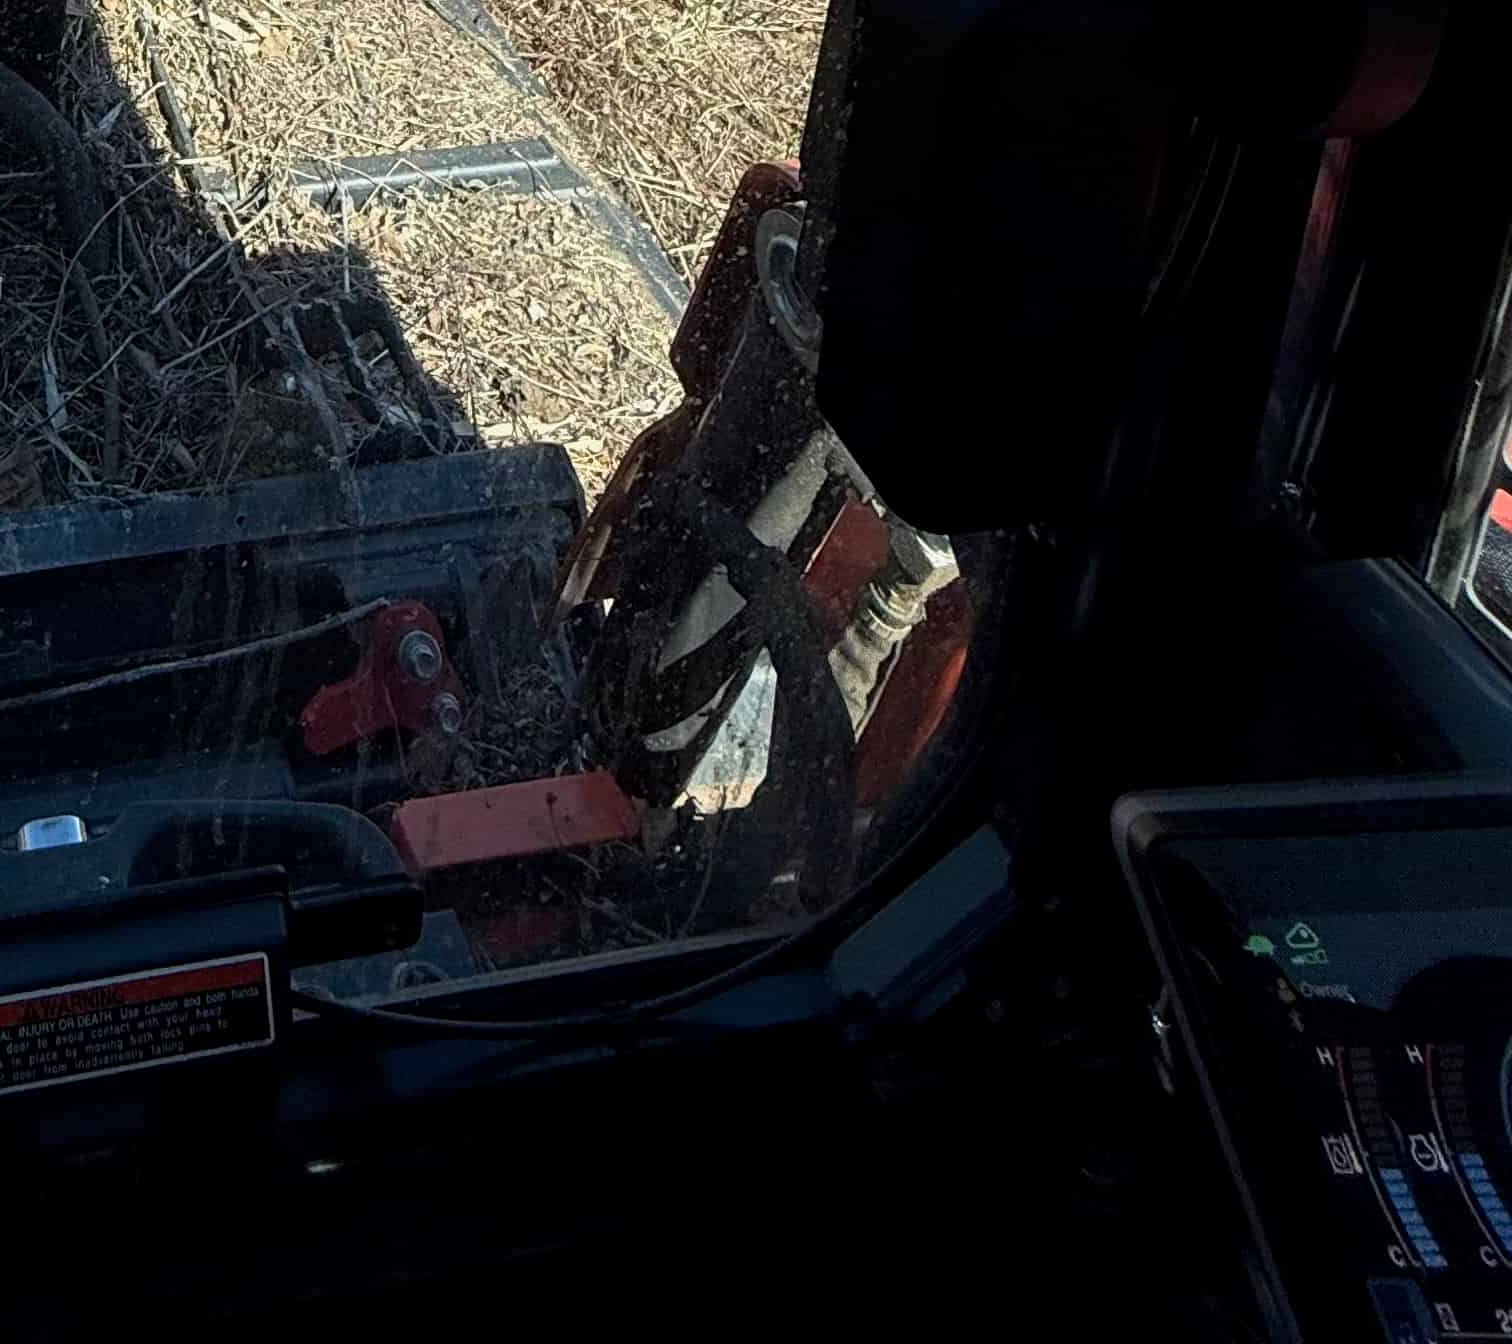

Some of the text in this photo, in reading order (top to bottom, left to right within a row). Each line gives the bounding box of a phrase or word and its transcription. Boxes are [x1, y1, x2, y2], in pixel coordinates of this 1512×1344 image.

[18, 1021, 56, 1039] INJURY
[58, 1018, 74, 1031] OR
[119, 1006, 139, 1021] Use
[183, 995, 200, 1009] and
[205, 991, 226, 1005] both
[231, 985, 260, 1001] hands
[39, 989, 121, 1017] WARNING
[6, 1041, 30, 1054] door
[36, 1037, 49, 1049] to
[55, 1031, 84, 1045] avoid
[90, 1023, 131, 1039] contact
[136, 1018, 160, 1031] with
[166, 1013, 189, 1028] your
[28, 1050, 58, 1067] place
[65, 1046, 78, 1060] by
[85, 1038, 123, 1056] moving
[129, 1033, 153, 1046] both
[1315, 1045, 1335, 1067] H
[1403, 1043, 1425, 1064] H
[1387, 1244, 1407, 1269] C
[1479, 1245, 1499, 1268] C
